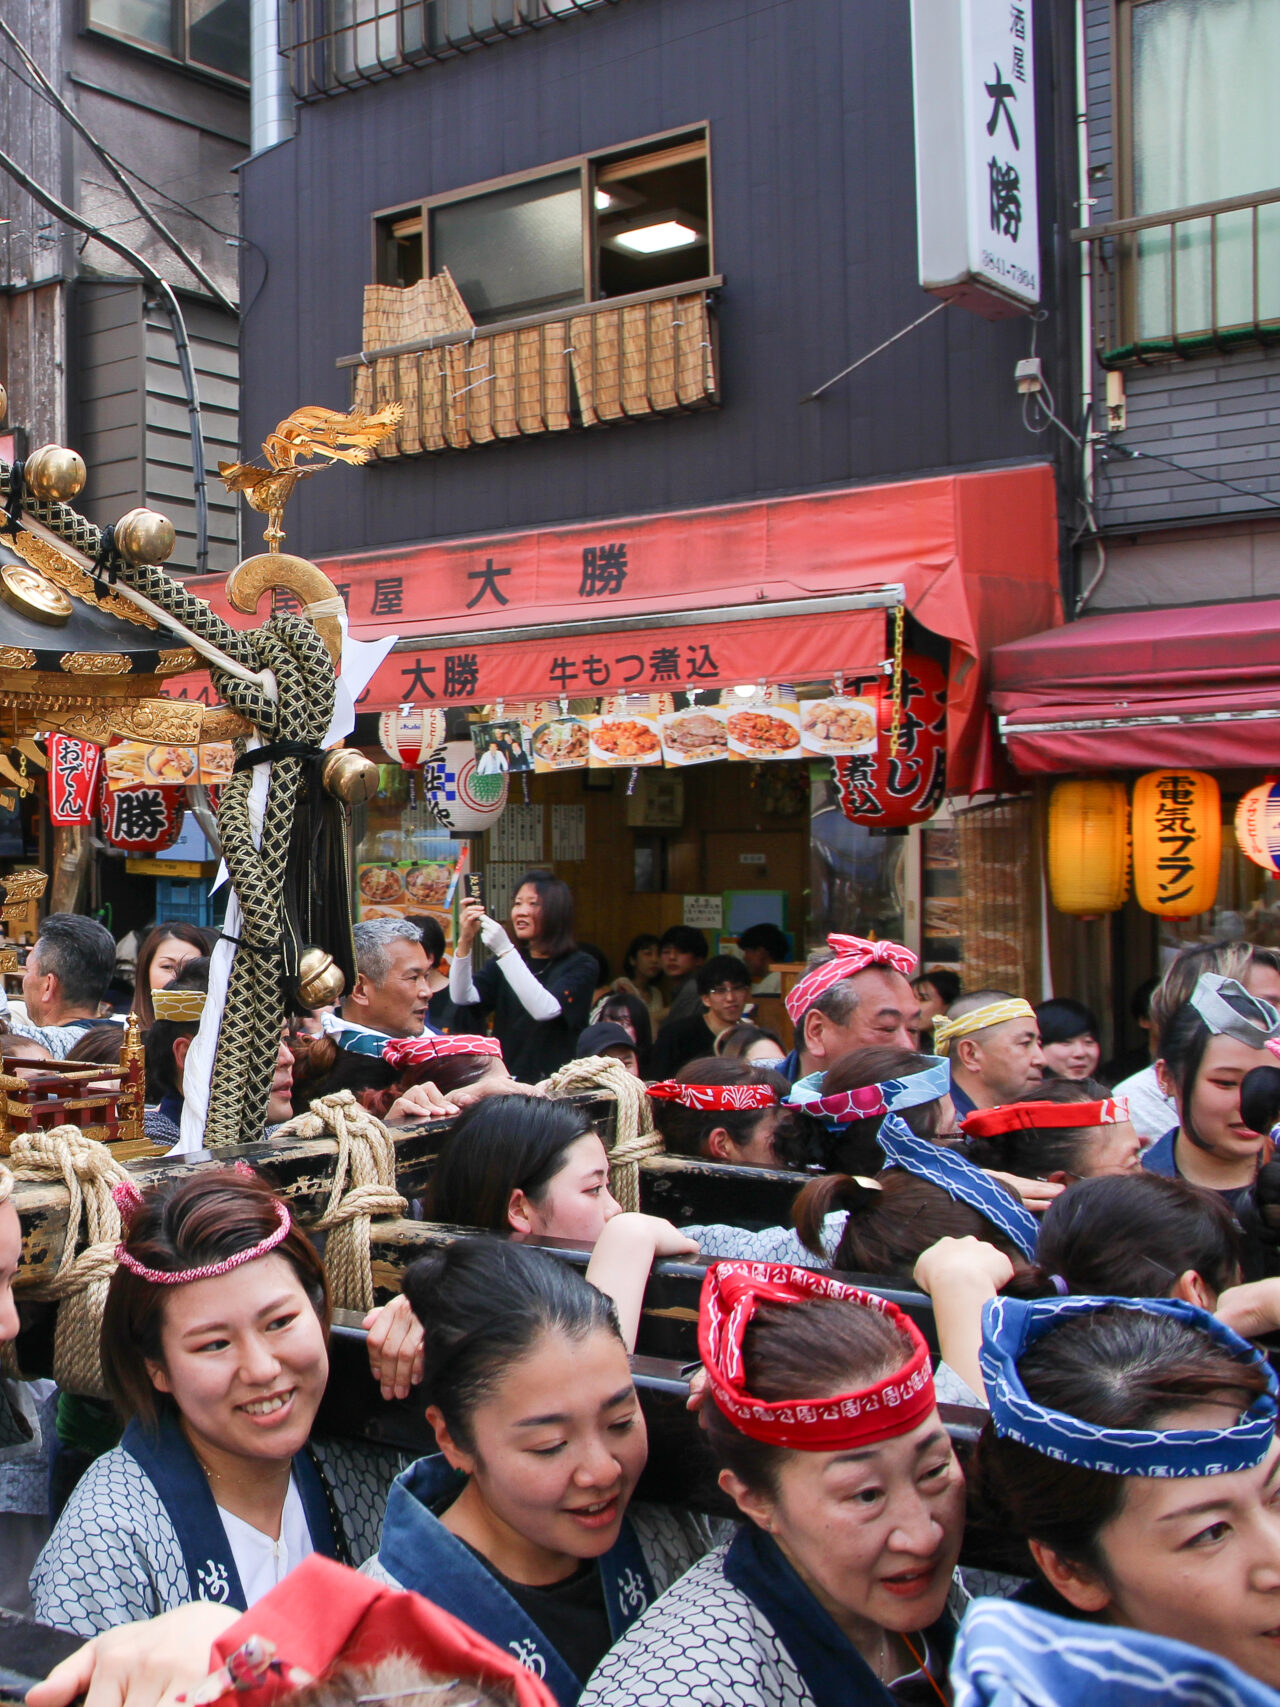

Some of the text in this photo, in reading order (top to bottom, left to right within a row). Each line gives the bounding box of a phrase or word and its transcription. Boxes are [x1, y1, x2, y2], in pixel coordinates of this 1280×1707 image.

[984, 62, 1022, 243] 大勝
[401, 645, 719, 701] 大勝 牛もつ煮込
[59, 740, 84, 816] おでん
